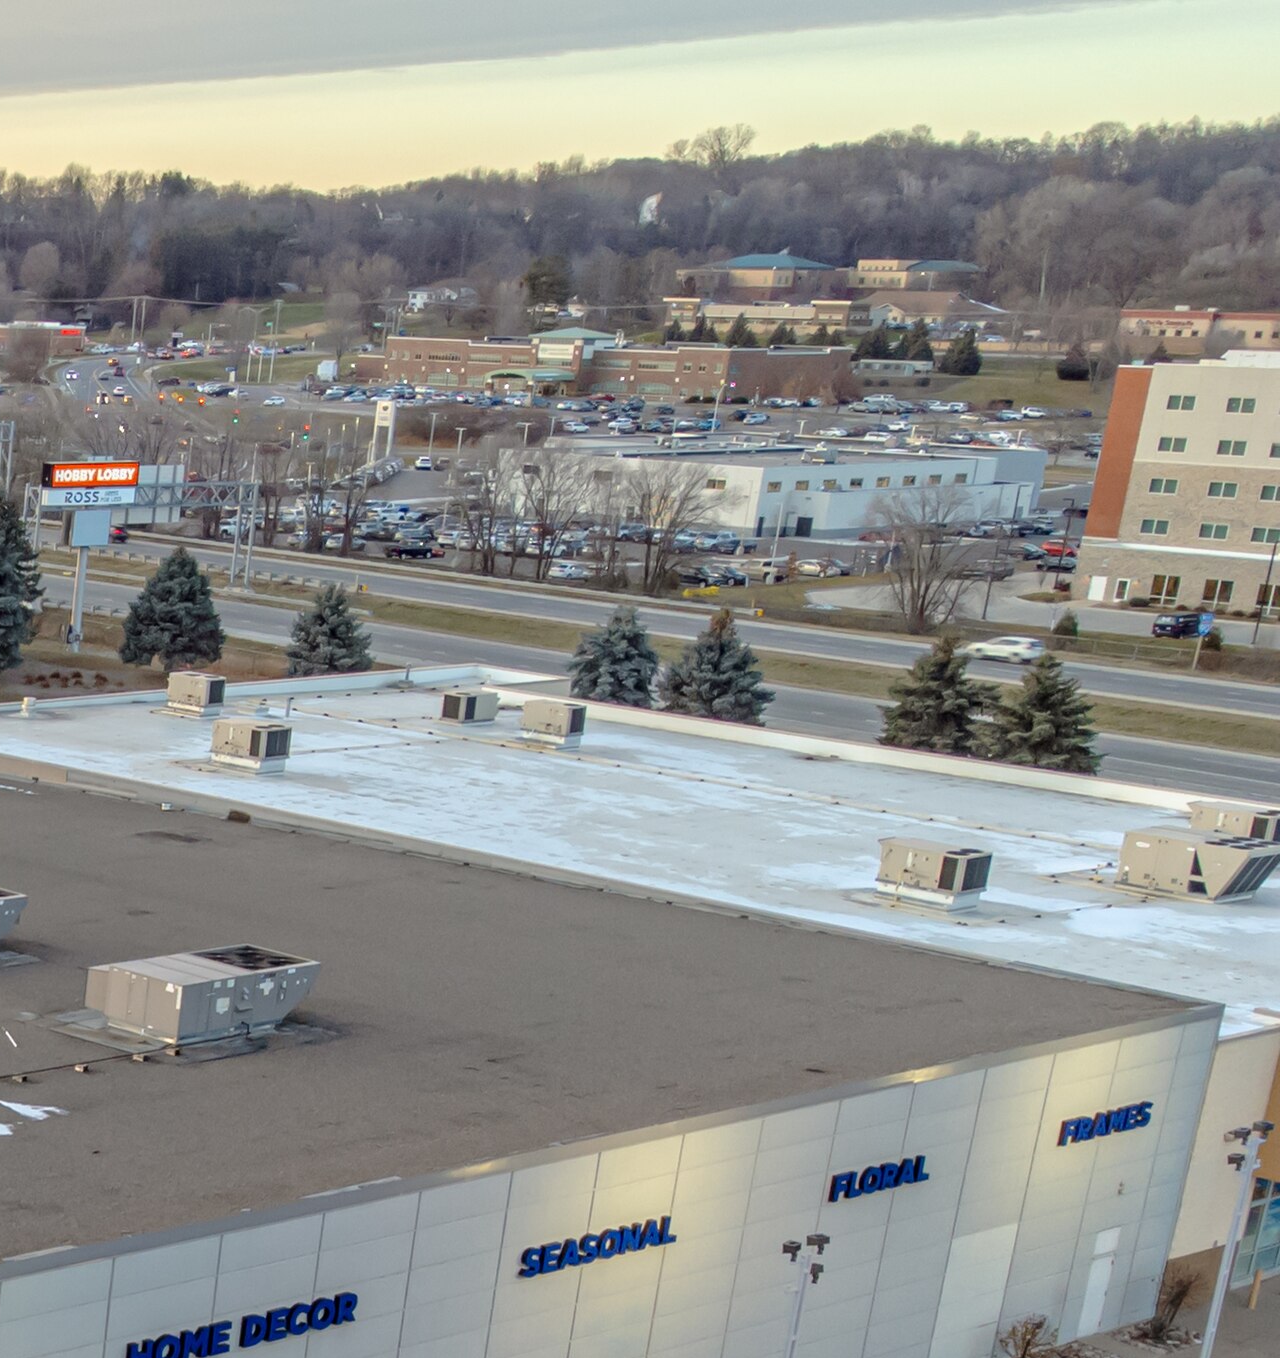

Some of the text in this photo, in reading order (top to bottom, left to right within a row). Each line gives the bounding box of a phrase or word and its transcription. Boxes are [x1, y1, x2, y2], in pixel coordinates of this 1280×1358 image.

[55, 467, 135, 482] HOBBY LOBBY
[65, 491, 99, 503] ROSS
[1058, 1101, 1154, 1147] FRAMES
[828, 1155, 930, 1202] FLORAL
[518, 1216, 677, 1279] SEASONAL
[239, 1292, 358, 1349] DECOR
